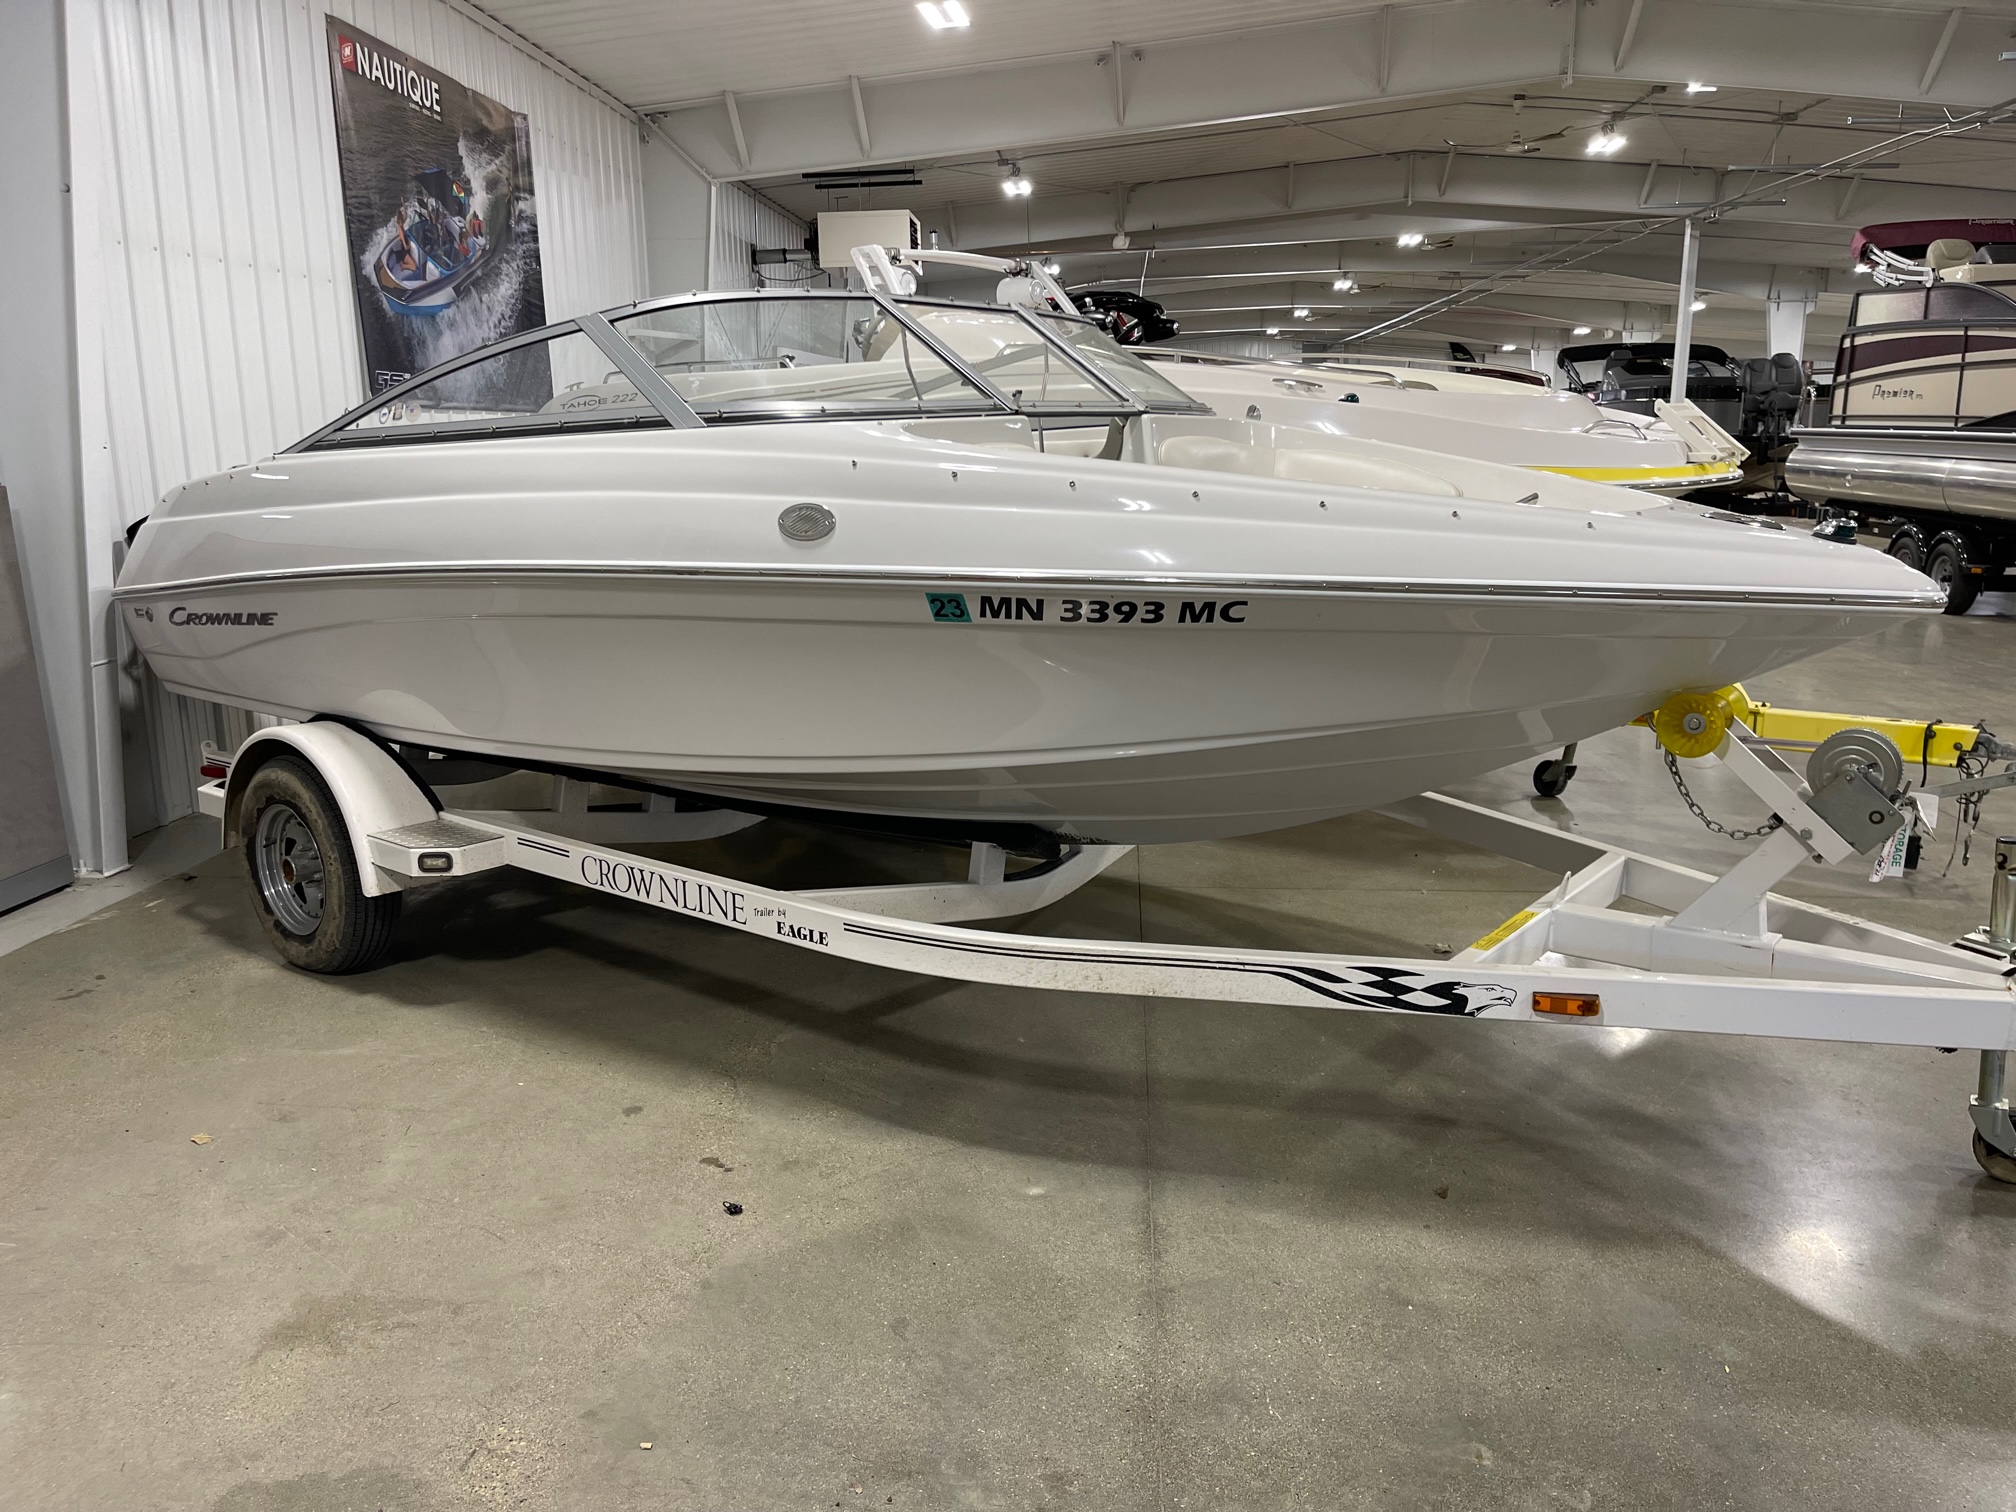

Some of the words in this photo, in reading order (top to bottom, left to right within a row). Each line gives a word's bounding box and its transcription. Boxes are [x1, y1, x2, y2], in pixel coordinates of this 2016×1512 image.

[355, 42, 441, 113] NAUTIQUE
[560, 397, 608, 411] TAHOE
[611, 392, 639, 404] 222
[168, 606, 278, 626] CROWNLINE
[929, 597, 966, 619] 23
[979, 595, 1045, 622] MN
[1059, 599, 1165, 624] 3393
[1177, 600, 1249, 624] MC
[1891, 825, 1907, 867] TORAGE
[580, 854, 748, 926] CROWNLINE
[753, 907, 774, 917] Trailer
[777, 907, 786, 918] by
[776, 920, 829, 947] EAGLE
